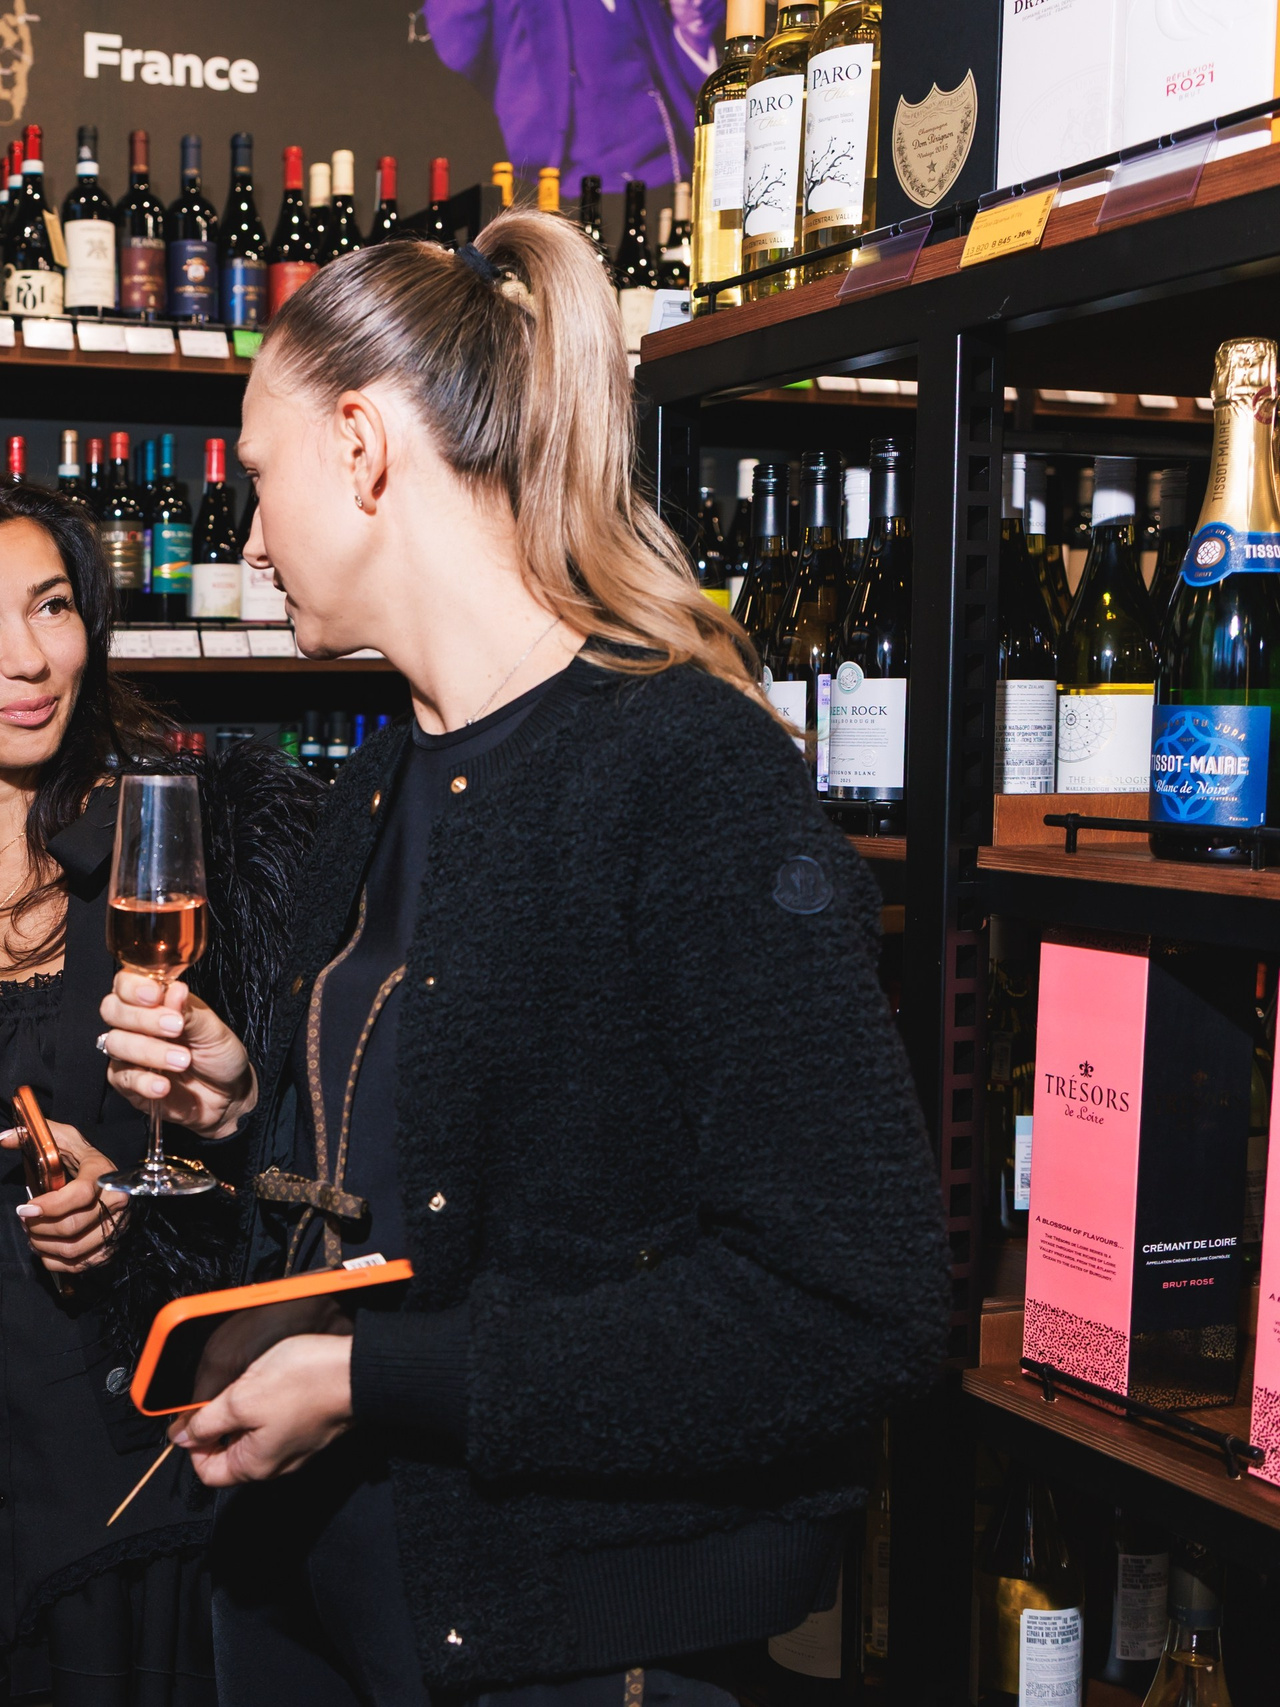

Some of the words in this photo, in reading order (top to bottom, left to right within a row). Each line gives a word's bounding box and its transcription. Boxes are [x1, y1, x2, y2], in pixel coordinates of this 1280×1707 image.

[84, 31, 259, 93] France
[812, 63, 862, 90] PARO
[749, 93, 793, 118] PARO
[912, 138, 928, 150] Dom
[1212, 418, 1231, 503] TISSOT-MAIRE
[851, 706, 888, 715] ROCK
[1215, 723, 1246, 741] JURA
[1151, 754, 1249, 775] TISSOT-MAIRE
[1069, 776, 1085, 784] THE
[1156, 779, 1179, 793] Blanc
[1180, 781, 1193, 793] de
[1196, 781, 1230, 795] Noirs
[1045, 1073, 1129, 1112] TRÉSORS
[1064, 1104, 1074, 1117] de
[1077, 1106, 1104, 1124] Loire
[1042, 1218, 1072, 1232] BLOSSOM
[1142, 1241, 1192, 1254] CRÉMANT
[1193, 1240, 1207, 1249] DE
[1208, 1237, 1237, 1248] LOIRE
[1162, 1280, 1188, 1289] BRUT
